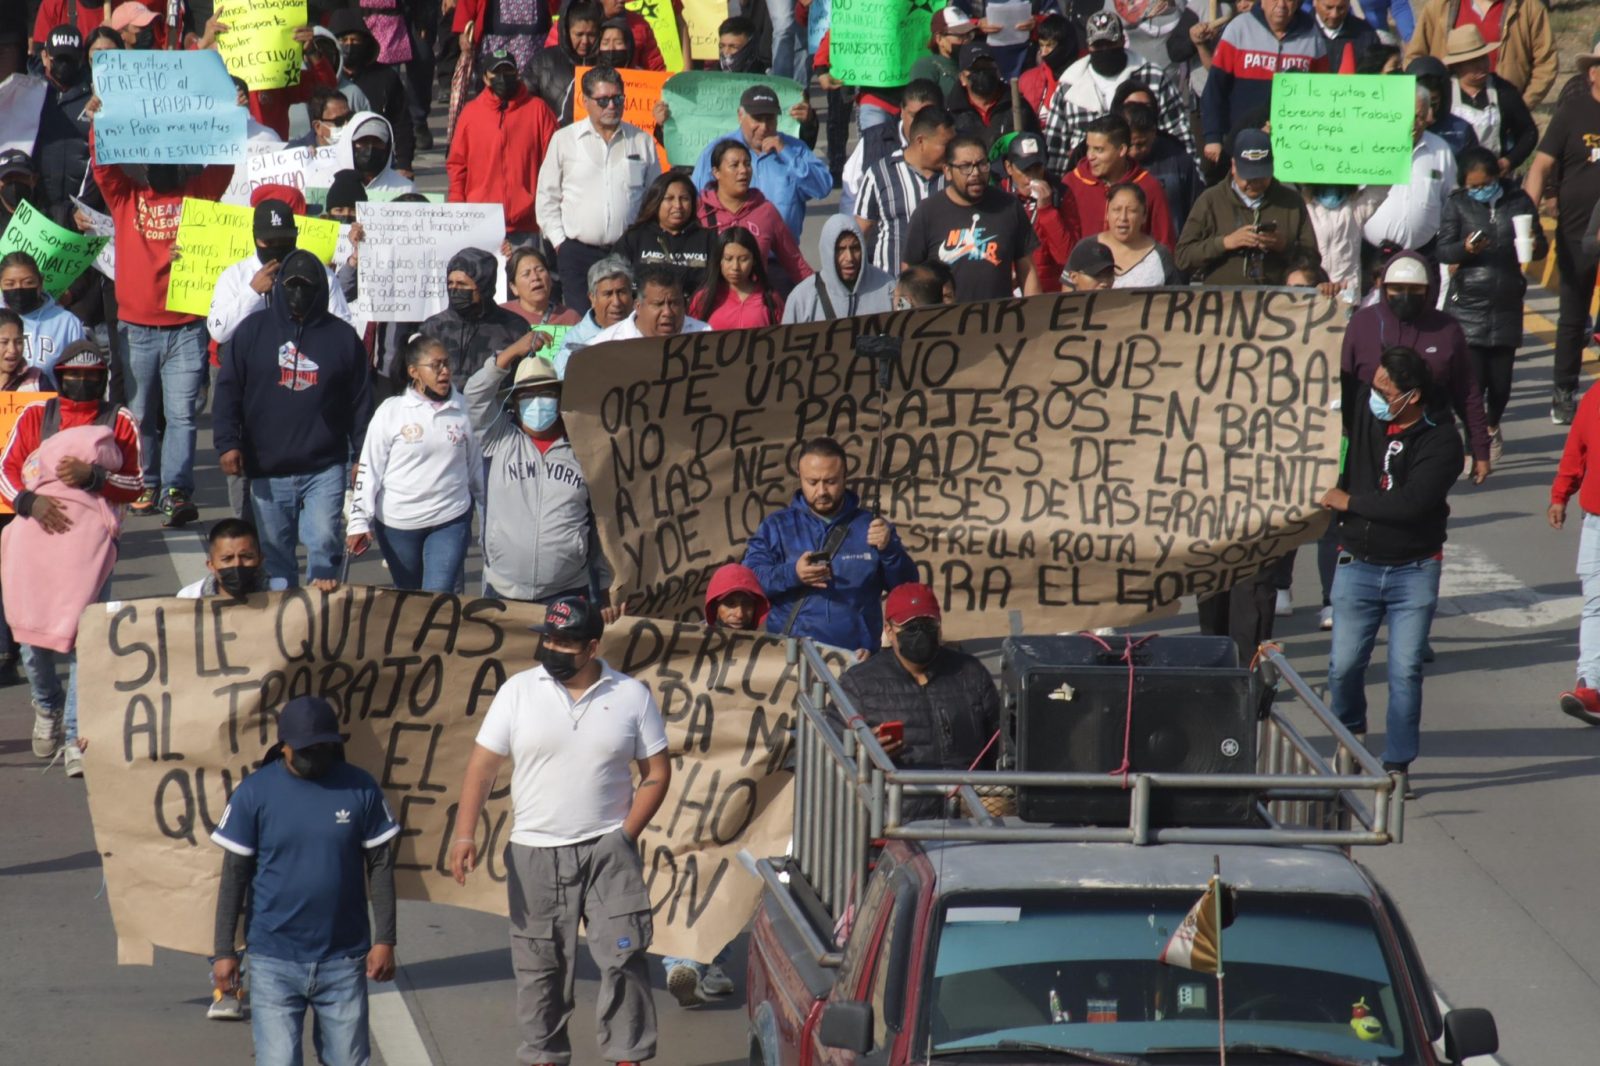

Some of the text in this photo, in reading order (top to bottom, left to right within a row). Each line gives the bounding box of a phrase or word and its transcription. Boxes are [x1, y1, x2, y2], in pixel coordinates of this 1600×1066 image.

[96, 72, 167, 94] DERECHO
[225, 48, 296, 69] COLECTIVO
[1244, 53, 1312, 73] PATRIOTS
[141, 95, 215, 118] TRABAJO
[168, 143, 241, 158] ESTUDIAR
[15, 203, 32, 225] NO
[8, 226, 83, 274] CRIMINALES
[661, 299, 1026, 381] REORGANIZAR
[1050, 295, 1108, 331] EL
[601, 372, 719, 434] ORTE
[745, 339, 961, 406] URBANO
[996, 337, 1028, 391] Y
[610, 386, 1328, 487] NO DE PASAJEROS EN BASE
[546, 462, 582, 490] YORK
[615, 428, 1339, 537] A LAS NECSIDADES DE LA GENTE
[623, 533, 645, 590] Y
[655, 509, 711, 575] DE
[1021, 477, 1069, 531] DE
[1079, 481, 1141, 529] LAS
[1145, 489, 1310, 543] GRANDES
[893, 521, 1036, 560] STRELLA
[1049, 528, 1137, 564] ROJA
[1152, 535, 1176, 569] Y
[1184, 538, 1281, 571] SON
[1037, 564, 1098, 607] EL
[108, 604, 168, 692] SI
[193, 596, 250, 677] LE
[275, 584, 507, 664] QUITAS
[123, 691, 185, 762] AL
[213, 654, 444, 754] TRABAJO
[381, 721, 448, 793] EL
